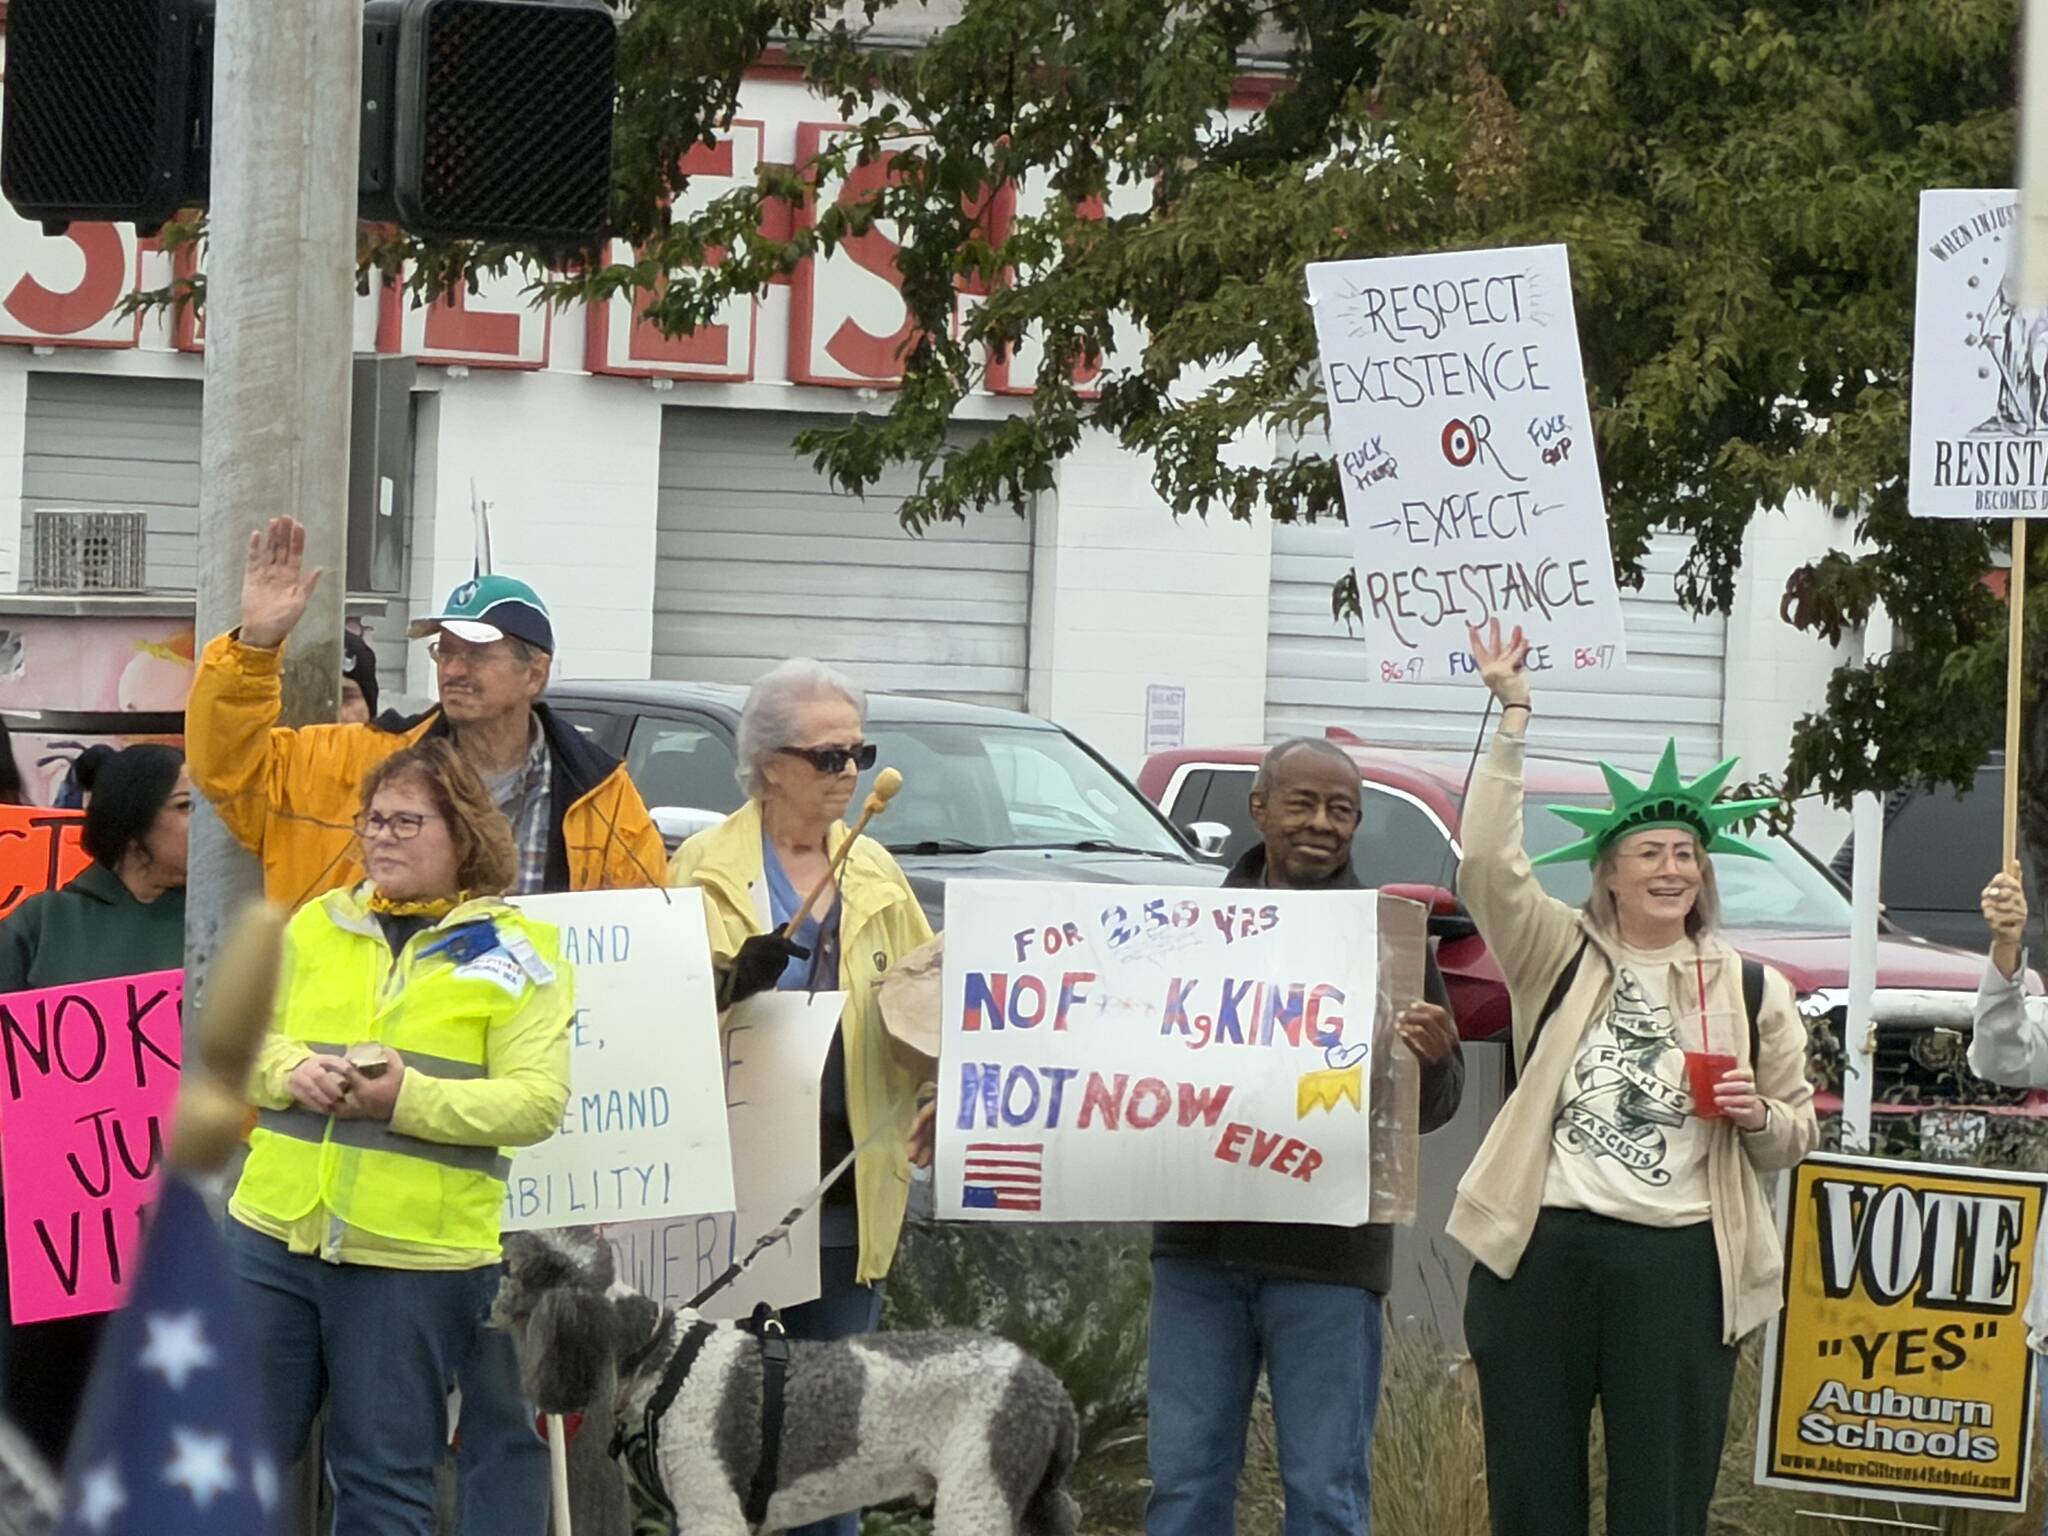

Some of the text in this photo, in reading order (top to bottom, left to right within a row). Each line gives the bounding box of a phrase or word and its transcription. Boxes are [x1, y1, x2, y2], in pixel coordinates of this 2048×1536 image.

[1929, 224, 1974, 262] WHEN
[1362, 274, 1525, 342] RESPECT
[1329, 342, 1550, 407] EXISTENCE
[1343, 435, 1390, 477] FUCK
[1441, 414, 1527, 481] OR
[1528, 414, 1572, 447] FUCK
[1402, 491, 1530, 547] EXPECT
[1976, 490, 2037, 510] BECOMES
[1366, 557, 1594, 648] RESISTANCE
[1014, 921, 1084, 963] FOR
[1214, 977, 1346, 1050] KING
[0, 993, 106, 1100] NO
[955, 1062, 1234, 1132] NOT NOW
[1214, 1122, 1324, 1184] EVER
[1572, 1110, 1652, 1167] FASCISTS
[1811, 1178, 2026, 1315] VOTE
[1818, 1321, 1998, 1380] "YES"
[1808, 1379, 1994, 1427] Auburn
[1797, 1412, 1999, 1463] Schools
